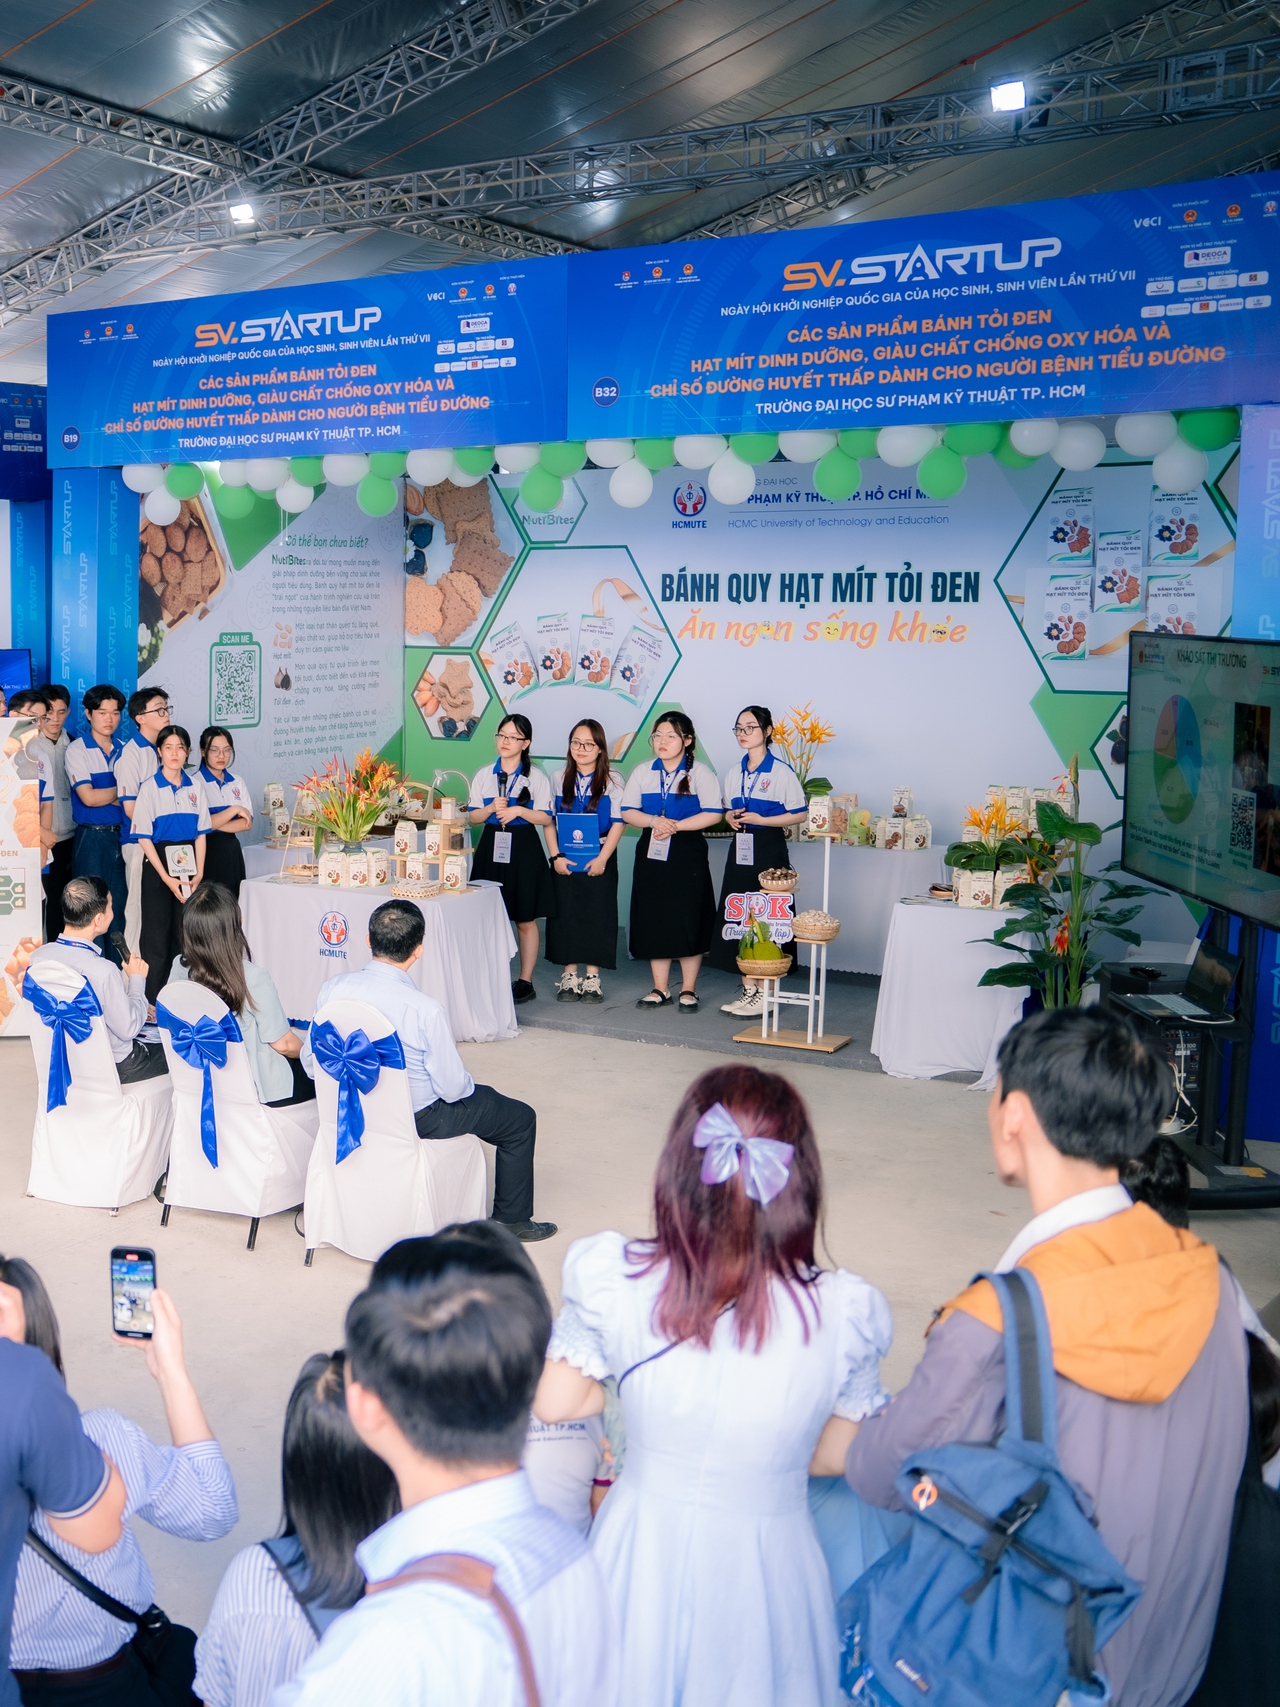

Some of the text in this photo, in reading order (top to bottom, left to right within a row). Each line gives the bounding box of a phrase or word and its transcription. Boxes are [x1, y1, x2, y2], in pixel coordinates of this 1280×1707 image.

[782, 238, 1062, 292] SV.STARTUP
[721, 269, 1135, 316] NGÀY HỘI KHỞI NGHIỆP QUỐC GIA CỦA HỌC SINH, SINH VIÊN LẦN THỨ VII
[194, 306, 382, 348] SV.STARTUP
[787, 308, 1051, 343] CÁC SẢN PHẨM BÁNH TỎI ĐEN
[691, 320, 1171, 375] HẠT MÍT DINH DƯỠNG, GIÀU CHẤT CHỐNG OXY HÓA VÀ
[649, 345, 1225, 397] CHỈ SỐ ĐƯỜNG HUYẾT THẤP DÀNH CHO NGƯỜI BỆNH TIỂU ĐƯỜNG
[595, 386, 617, 399] B32
[755, 384, 1085, 414] TRƯỜNG ĐẠI HỌC SƯ PHẠM KỸ THUẬT TP. HCM
[64, 434, 78, 443] B19
[747, 493, 781, 506] PHẠM
[786, 491, 800, 502] KỸ
[865, 485, 884, 500] HỒ
[888, 486, 911, 499] CHÍ
[672, 520, 707, 529] HCMUTE
[728, 515, 949, 528] HCMC University of Technology and Education
[661, 563, 979, 609] BÁNH QUY HẠT MÍT TỎI ĐEN
[223, 635, 249, 643] SCAN ME
[319, 948, 347, 960] HCMUTE
